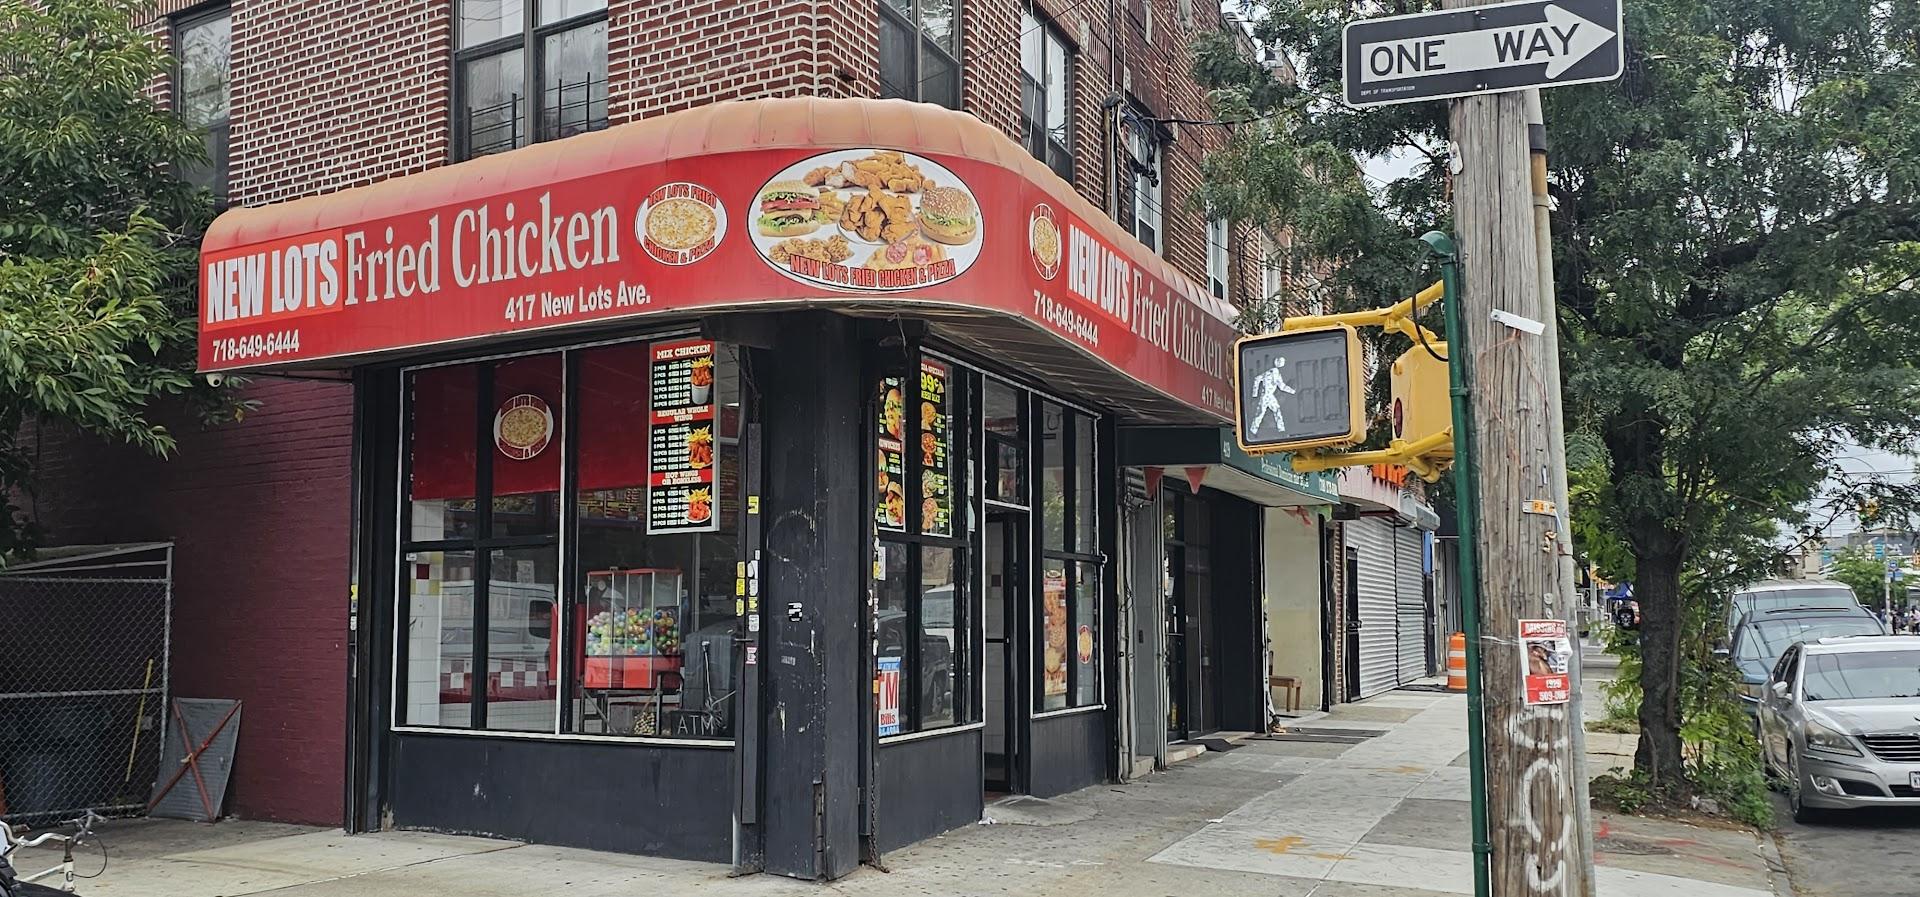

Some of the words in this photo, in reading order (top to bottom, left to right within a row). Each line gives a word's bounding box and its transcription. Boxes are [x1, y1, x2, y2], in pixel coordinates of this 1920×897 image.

[1370, 39, 1446, 77] ONE
[1493, 22, 1580, 63] WAY
[647, 186, 667, 209] NEW
[667, 183, 691, 199] LOTS
[690, 185, 718, 209] FRIED
[207, 253, 266, 324] NEW
[271, 239, 339, 313] LOTS
[344, 213, 440, 306] Fried
[451, 191, 620, 289] Chicken
[643, 235, 679, 264] CHICKEN
[680, 252, 688, 264] &
[688, 235, 716, 262] PIZZA
[790, 254, 821, 277] NEW
[821, 262, 849, 285] LOTS
[850, 267, 877, 288] FRIED
[877, 267, 917, 288] CHICKEN
[918, 267, 927, 284] &
[927, 258, 956, 282] PIZZA
[505, 294, 536, 323] 417
[540, 291, 575, 317] New
[579, 285, 612, 313] Lots
[617, 280, 652, 306] Ave.
[1033, 289, 1099, 347] 718-649-6444
[1069, 223, 1100, 304] NEW
[1100, 246, 1130, 323] LOTS
[1130, 267, 1170, 352] Fried
[1172, 298, 1222, 380] Chicken
[212, 329, 301, 362] 718-649-6444
[656, 349, 674, 359] MIX
[675, 344, 711, 357] CHICKEN
[1201, 385, 1213, 407] 417
[677, 715, 714, 735] ATM
